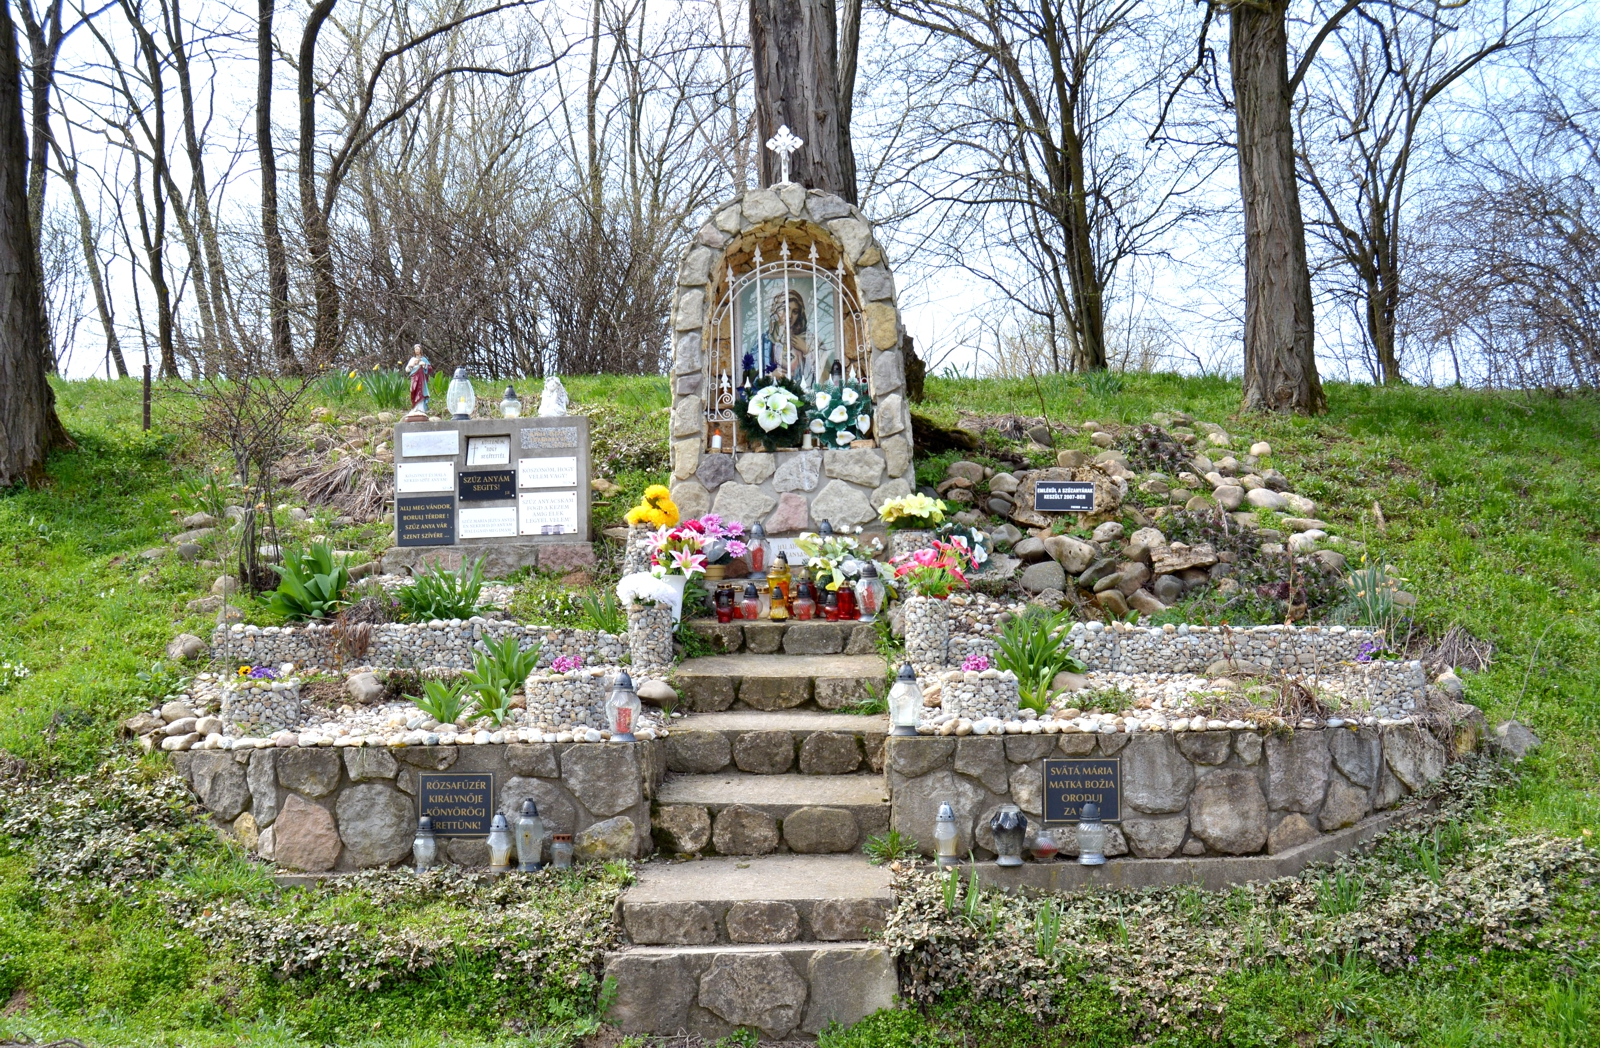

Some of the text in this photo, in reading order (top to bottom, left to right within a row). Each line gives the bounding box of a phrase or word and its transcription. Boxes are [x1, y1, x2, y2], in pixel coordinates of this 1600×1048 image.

[482, 474, 510, 482] ANYÁM
[1050, 765, 1113, 775] SVÄTÁ MÁRIA
[426, 779, 486, 789] RÓZSAFŰZÉR
[1049, 779, 1115, 789] MATKA BOŽIA
[429, 793, 483, 804] KIRÁLYNŐJE
[1061, 793, 1102, 804] ORODUJ
[426, 806, 485, 817] KÖNYÖRÖGJ
[1063, 807, 1076, 816] ZA
